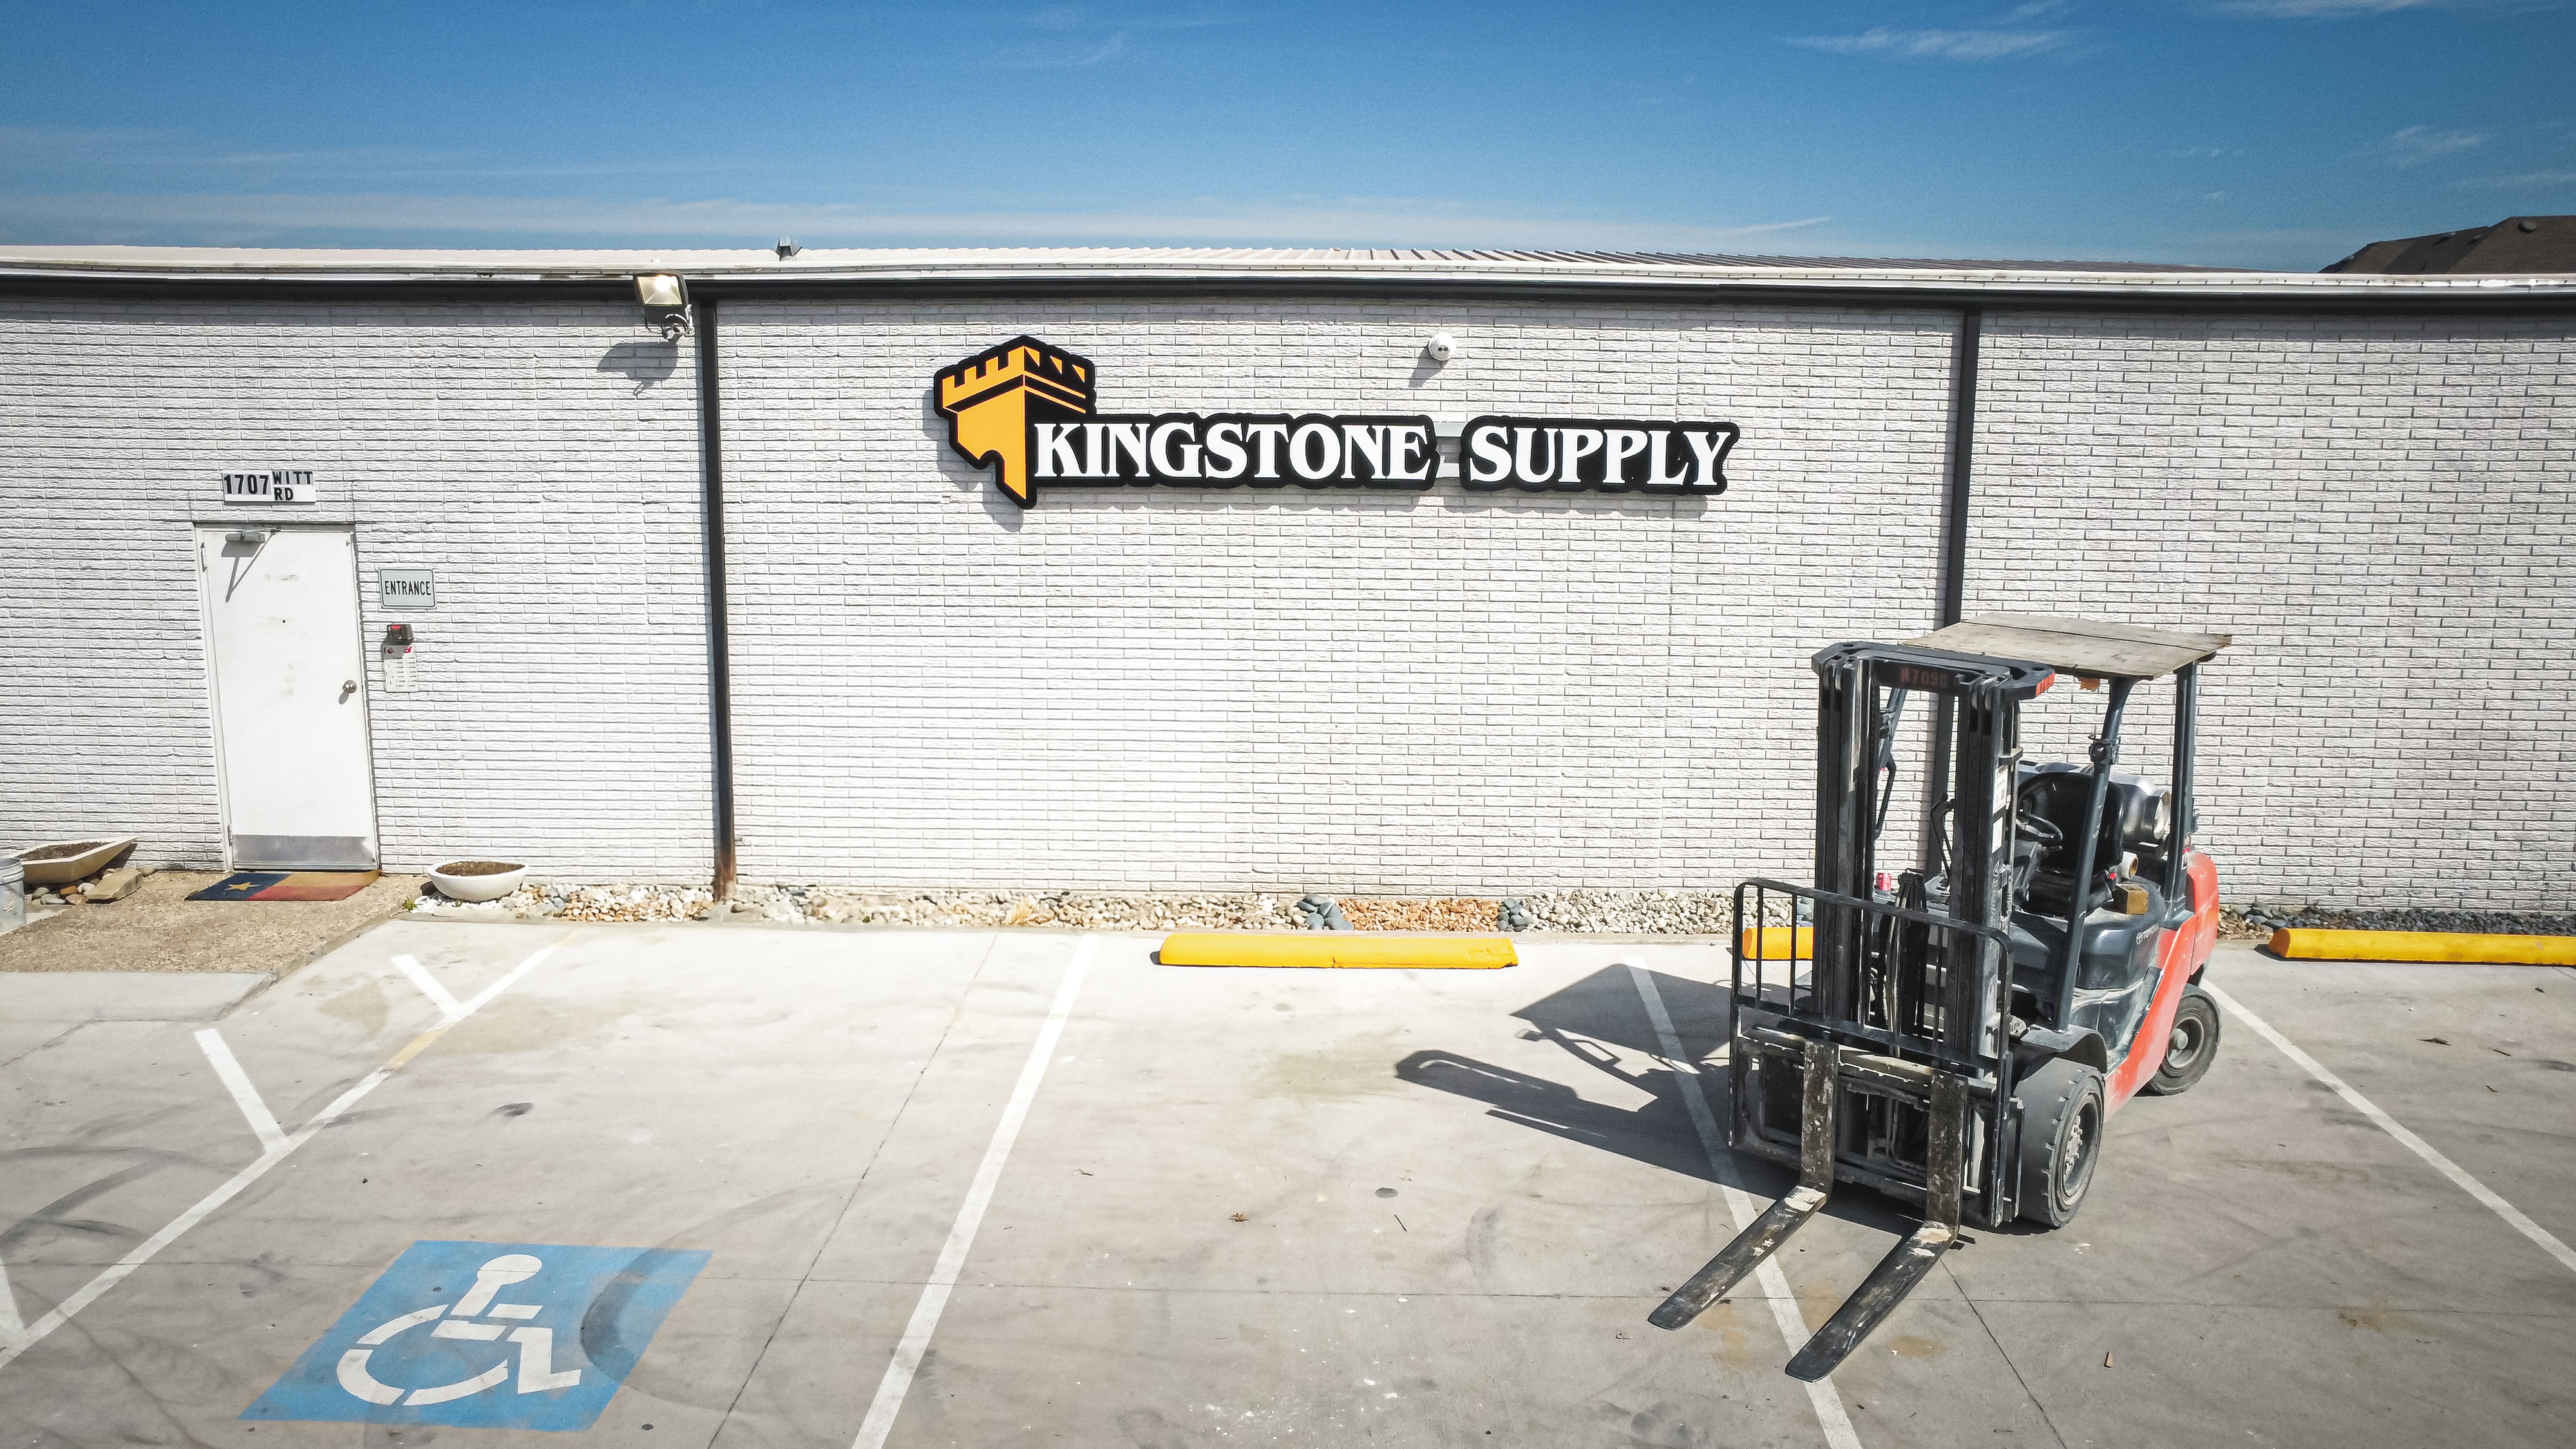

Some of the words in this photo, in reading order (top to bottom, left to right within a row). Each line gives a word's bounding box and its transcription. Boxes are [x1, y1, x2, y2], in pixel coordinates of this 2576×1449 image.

[1034, 422, 1431, 480] KINGSTONE
[1470, 426, 1730, 486] SUPPLY
[224, 474, 269, 495] 1707
[272, 471, 312, 484] WITT
[274, 488, 294, 500] RD
[384, 580, 431, 596] ENTRANCE
